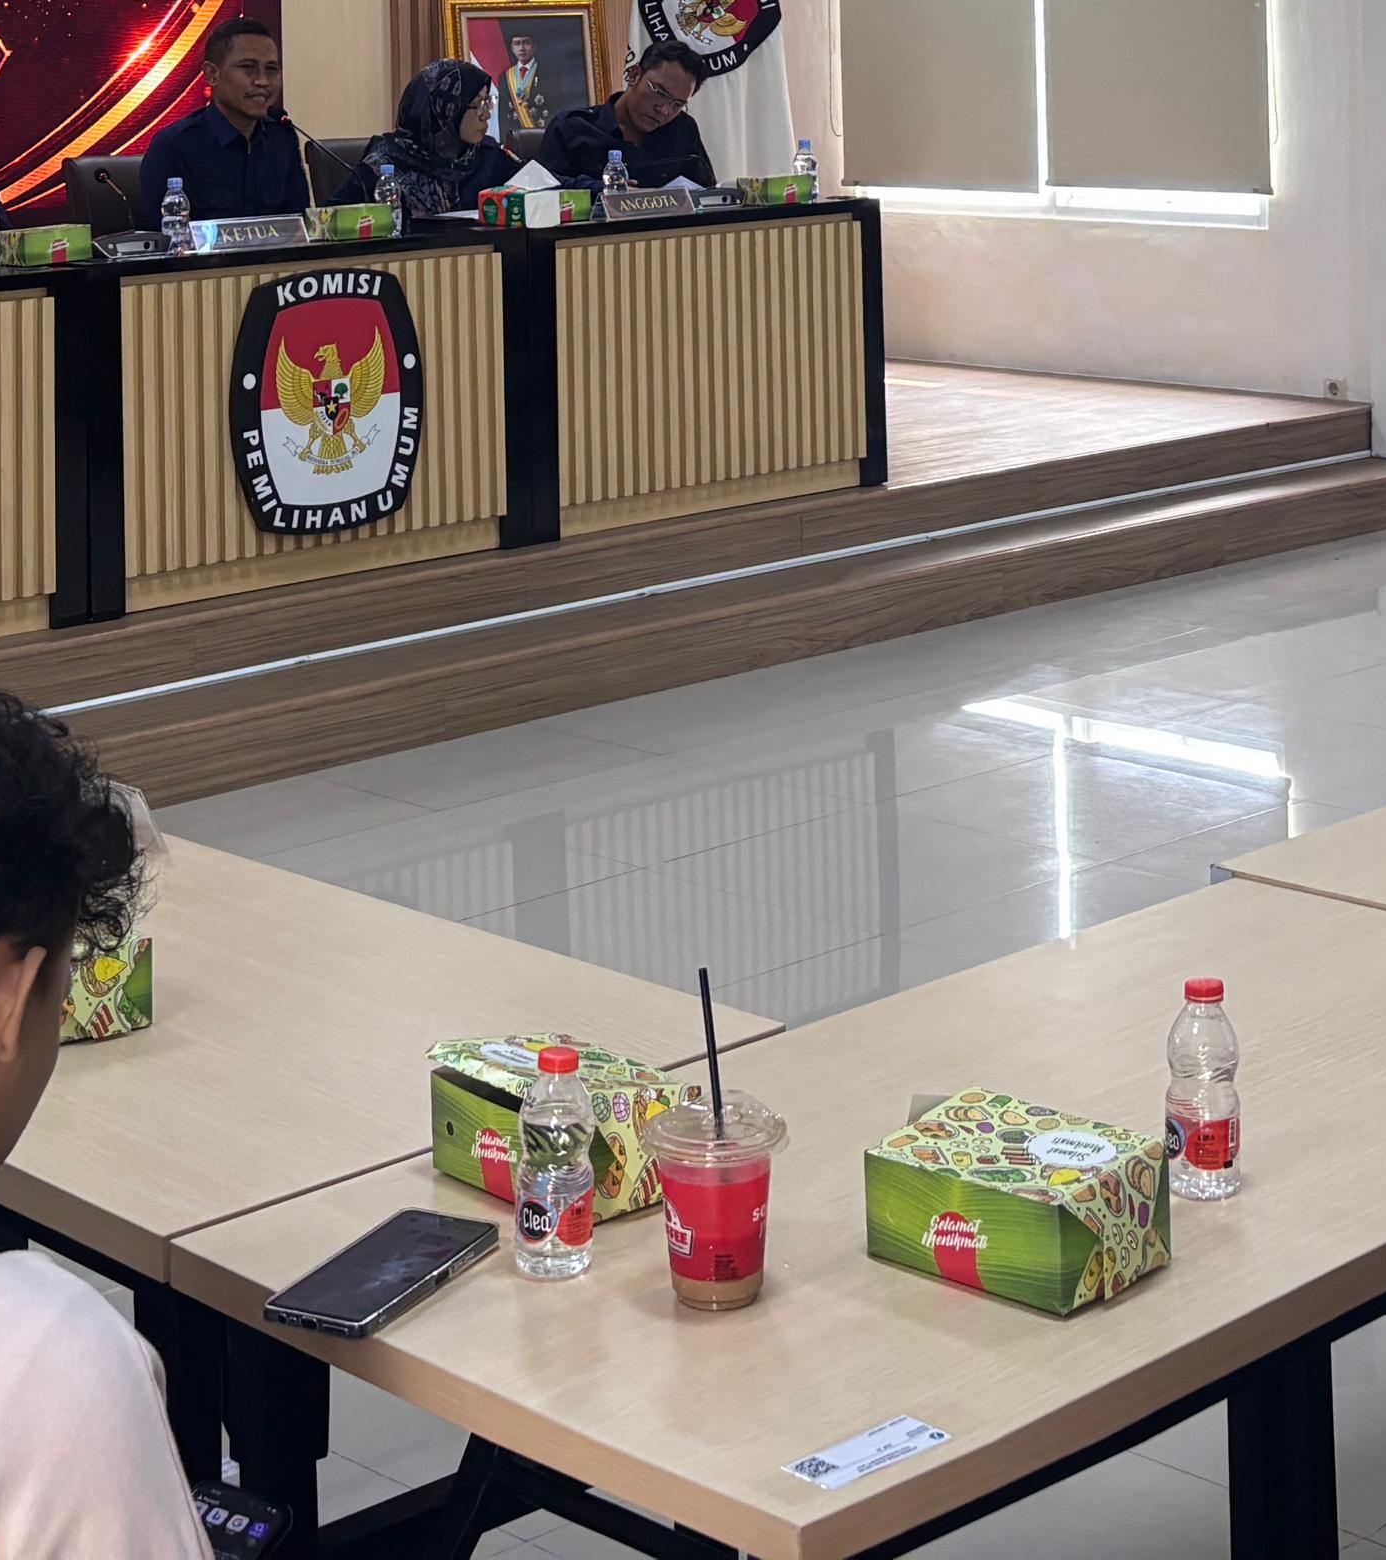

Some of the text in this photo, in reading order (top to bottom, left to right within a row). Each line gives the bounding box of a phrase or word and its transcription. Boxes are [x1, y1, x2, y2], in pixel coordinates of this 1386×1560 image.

[620, 195, 678, 212] ANGGOTA
[220, 224, 280, 243] KETUA
[276, 272, 382, 307] KOMISI
[243, 406, 419, 530] PEMILIHAN UMUM
[930, 1214, 983, 1234] Selamat
[921, 1231, 989, 1252] Menikmati
